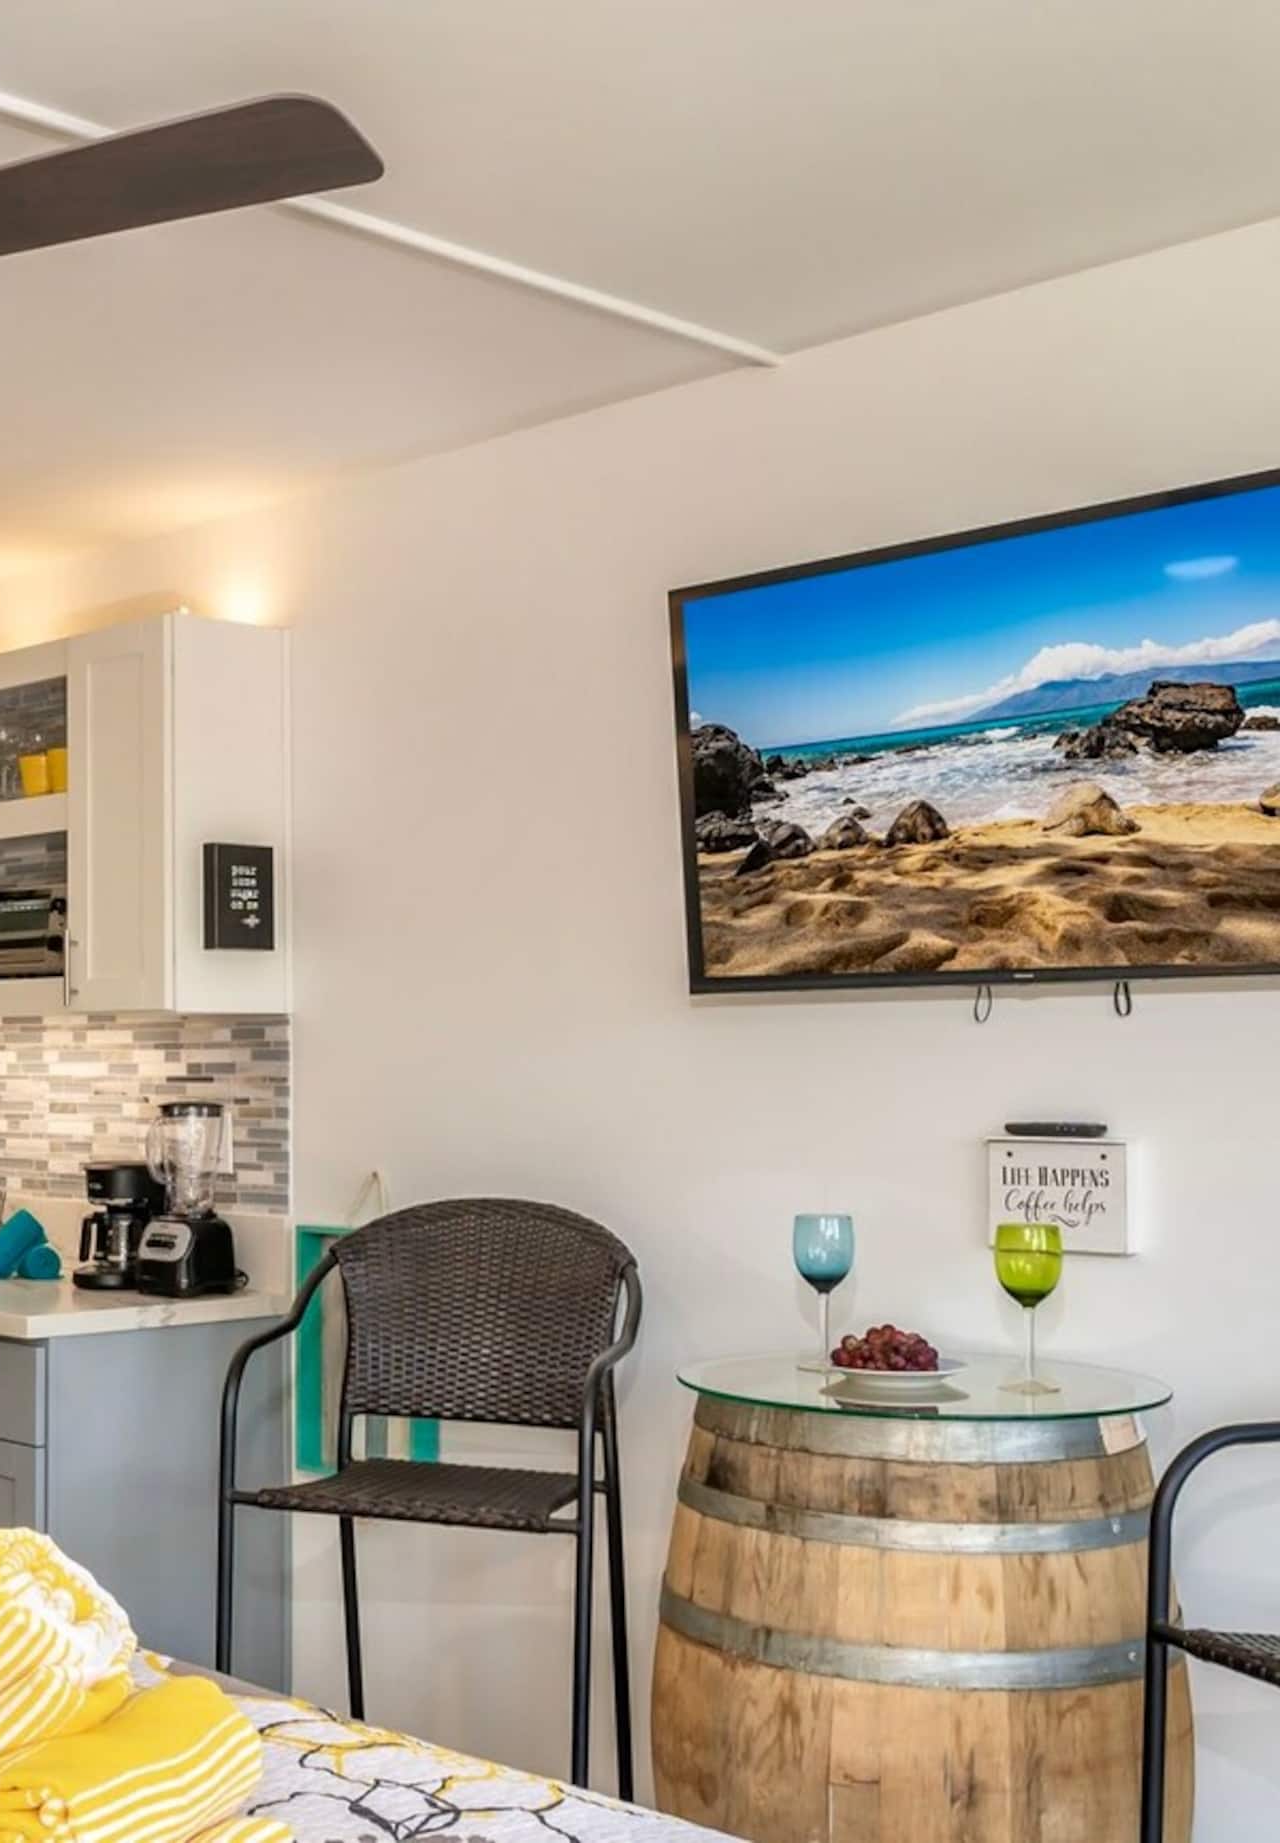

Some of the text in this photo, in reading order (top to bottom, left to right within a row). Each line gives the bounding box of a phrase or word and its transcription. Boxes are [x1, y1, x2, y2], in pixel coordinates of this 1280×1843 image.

[1038, 1166, 1110, 1188] HAPPENS
[1004, 1188, 1106, 1225] Coffee helps
